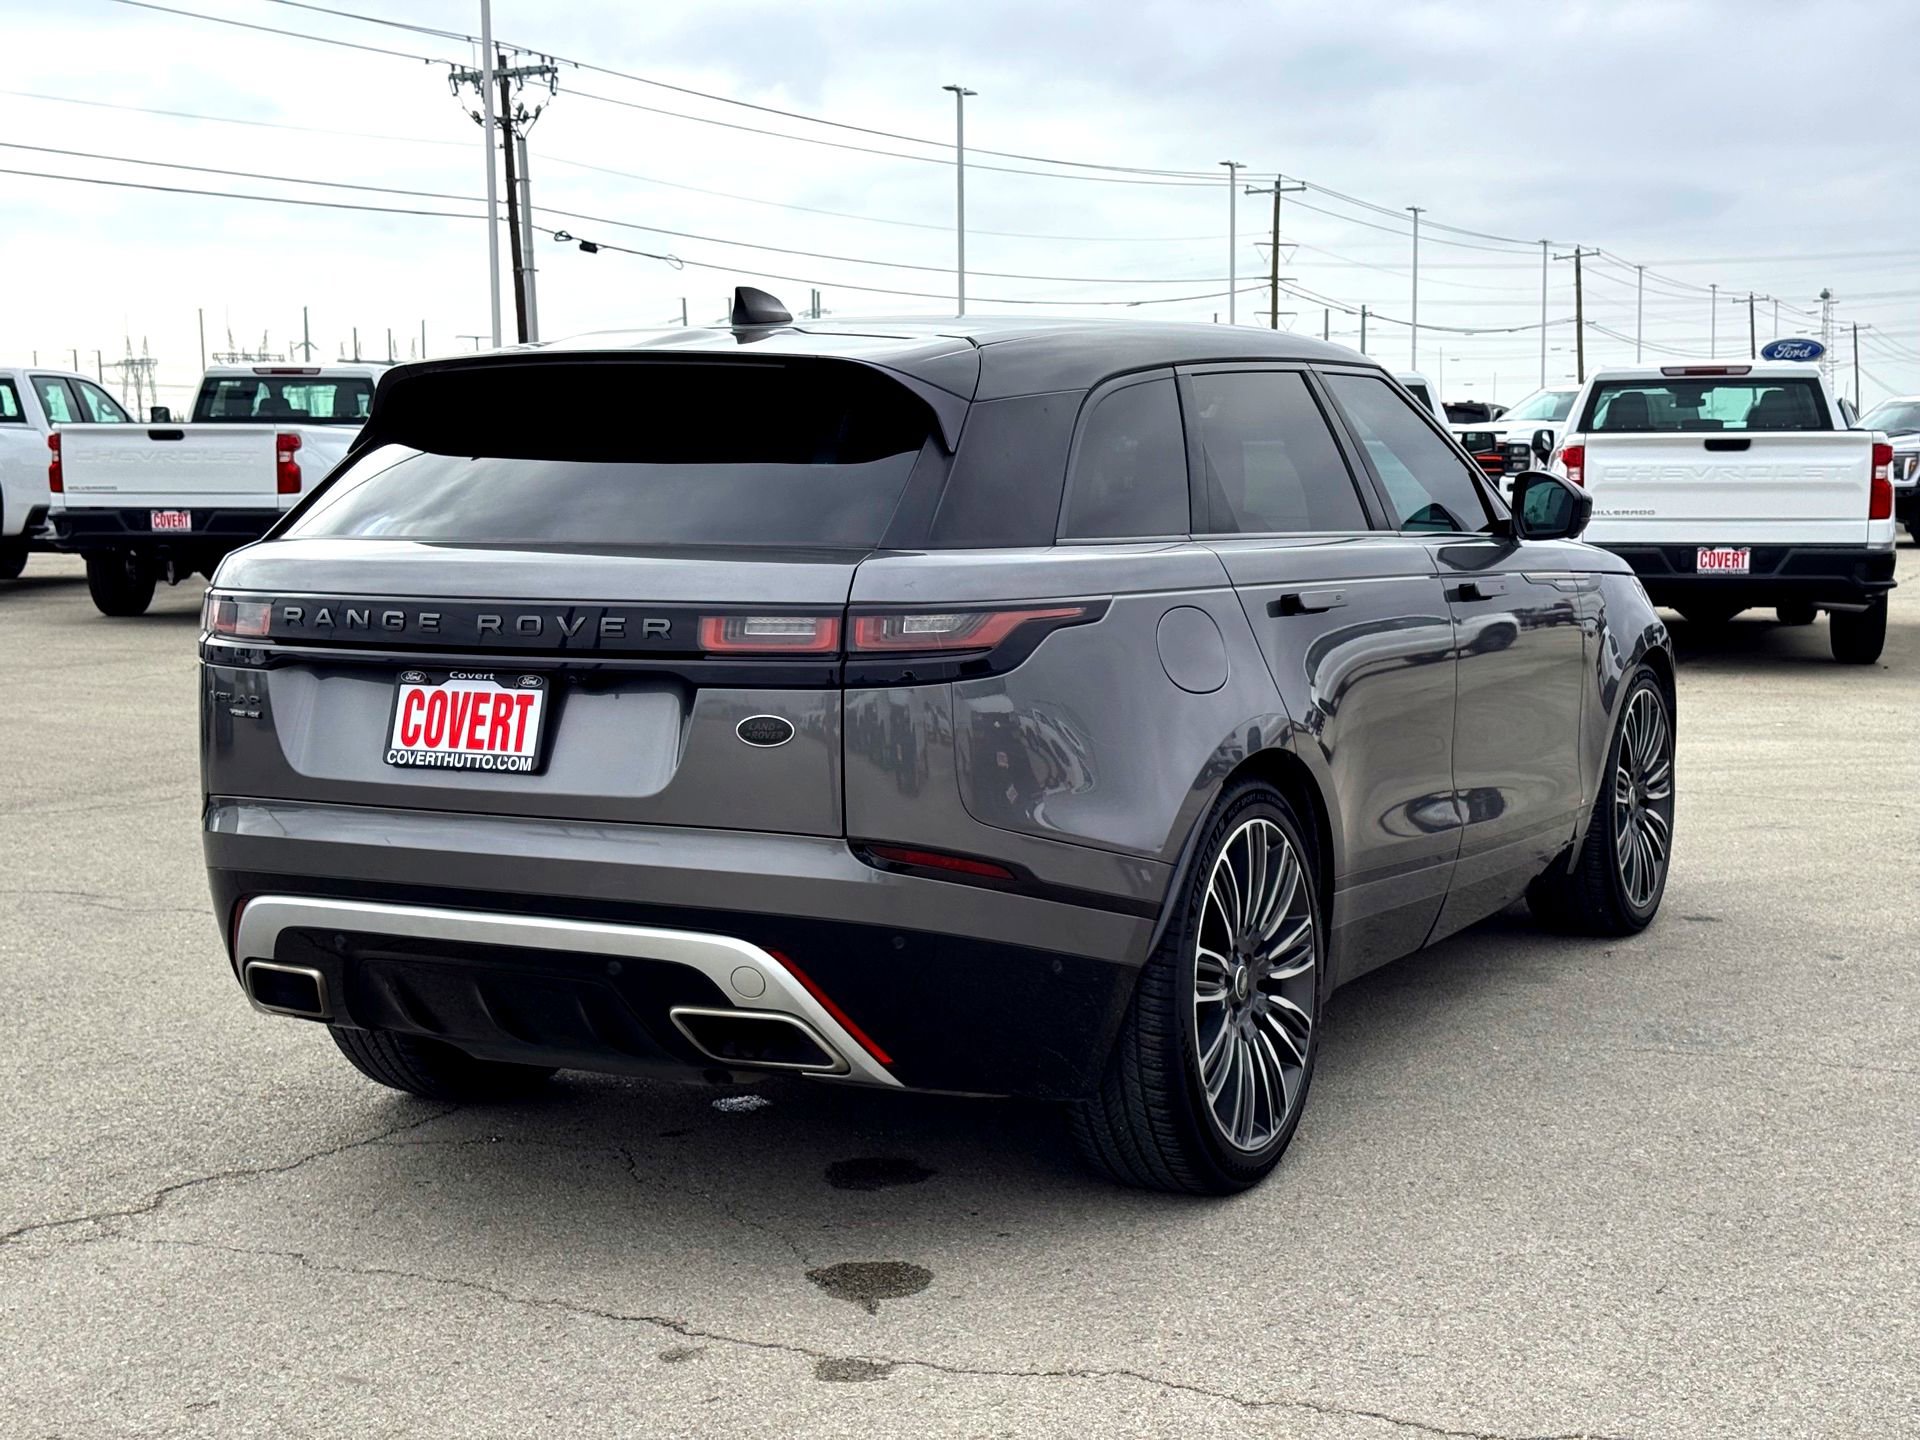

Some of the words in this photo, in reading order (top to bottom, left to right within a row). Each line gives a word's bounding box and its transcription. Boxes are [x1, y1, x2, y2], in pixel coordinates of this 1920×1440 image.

[1774, 343, 1811, 358] Ford
[1602, 465, 1852, 481] CHEVROLET
[153, 512, 189, 529] COVERT
[1700, 551, 1748, 568] COVERT
[283, 606, 440, 633] RANGE
[477, 614, 671, 640] ROVER
[449, 671, 495, 680] Covert
[401, 688, 535, 753] COVERT
[386, 750, 533, 772] COVERTHUTTO.COM
